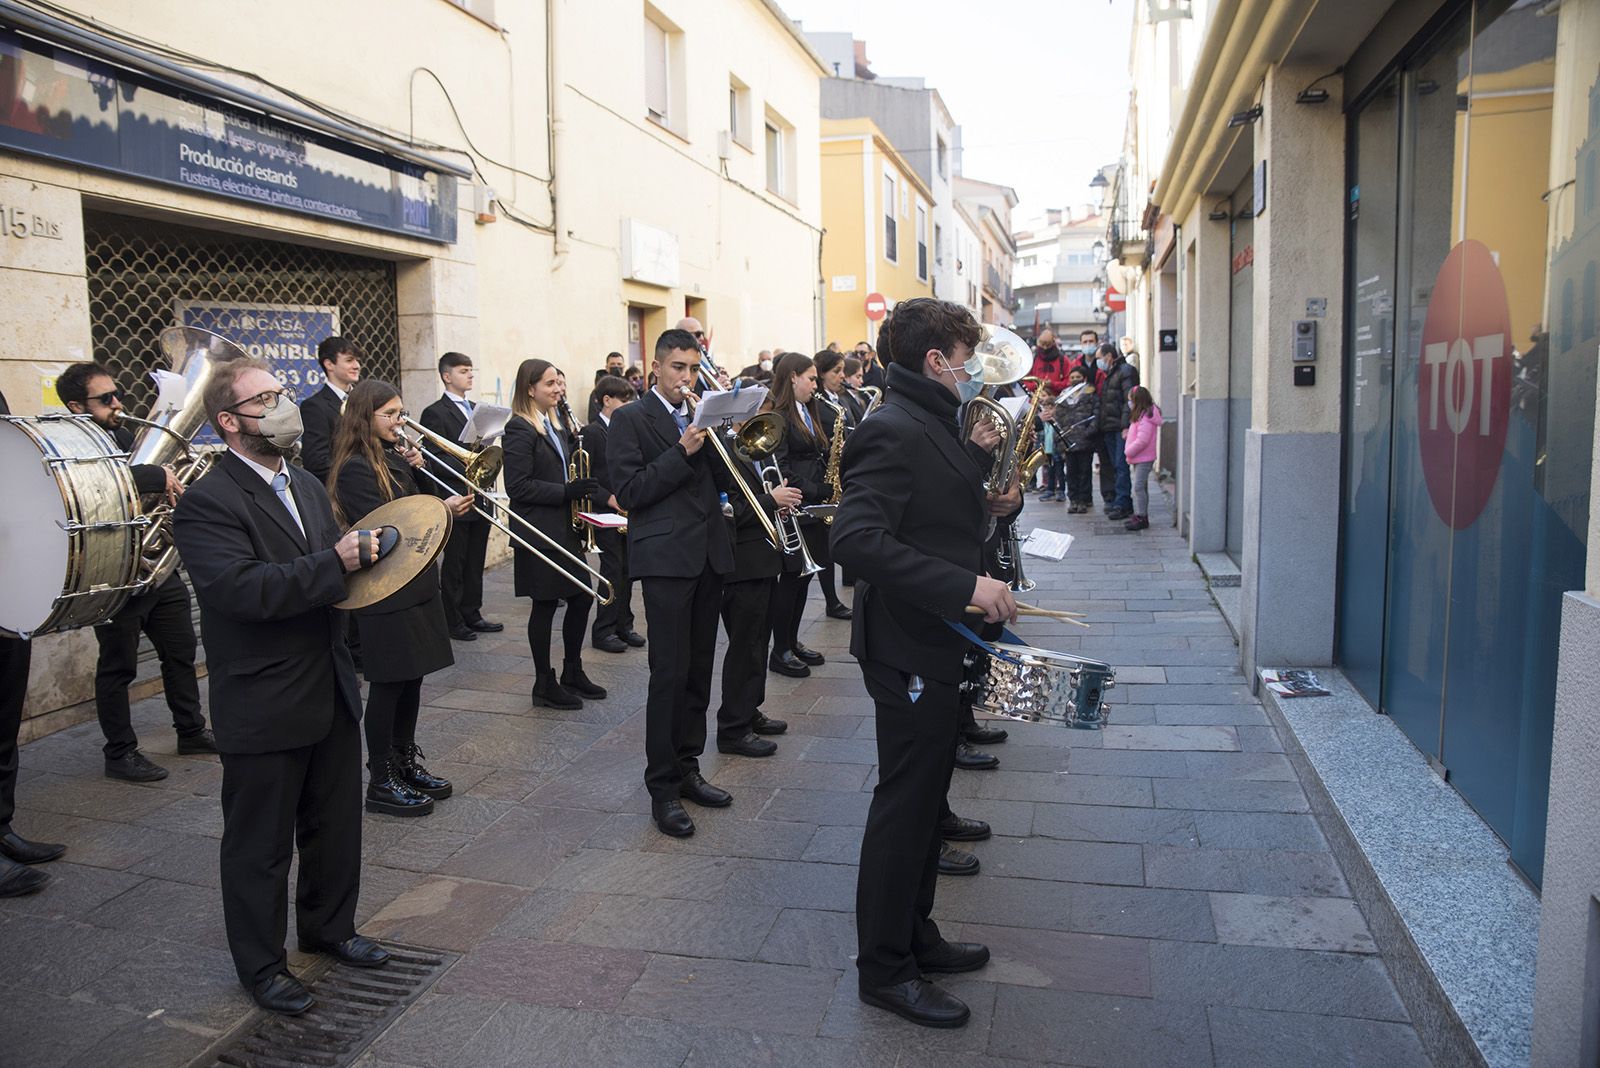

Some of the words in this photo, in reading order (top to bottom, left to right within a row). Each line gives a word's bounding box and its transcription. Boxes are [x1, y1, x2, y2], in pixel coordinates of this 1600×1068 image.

[180, 143, 244, 175] Producció
[244, 160, 298, 189] d'estands
[180, 166, 222, 192] Fusteria,
[0, 202, 27, 240] 15
[257, 318, 306, 332] CASA
[1424, 333, 1505, 436] TOT
